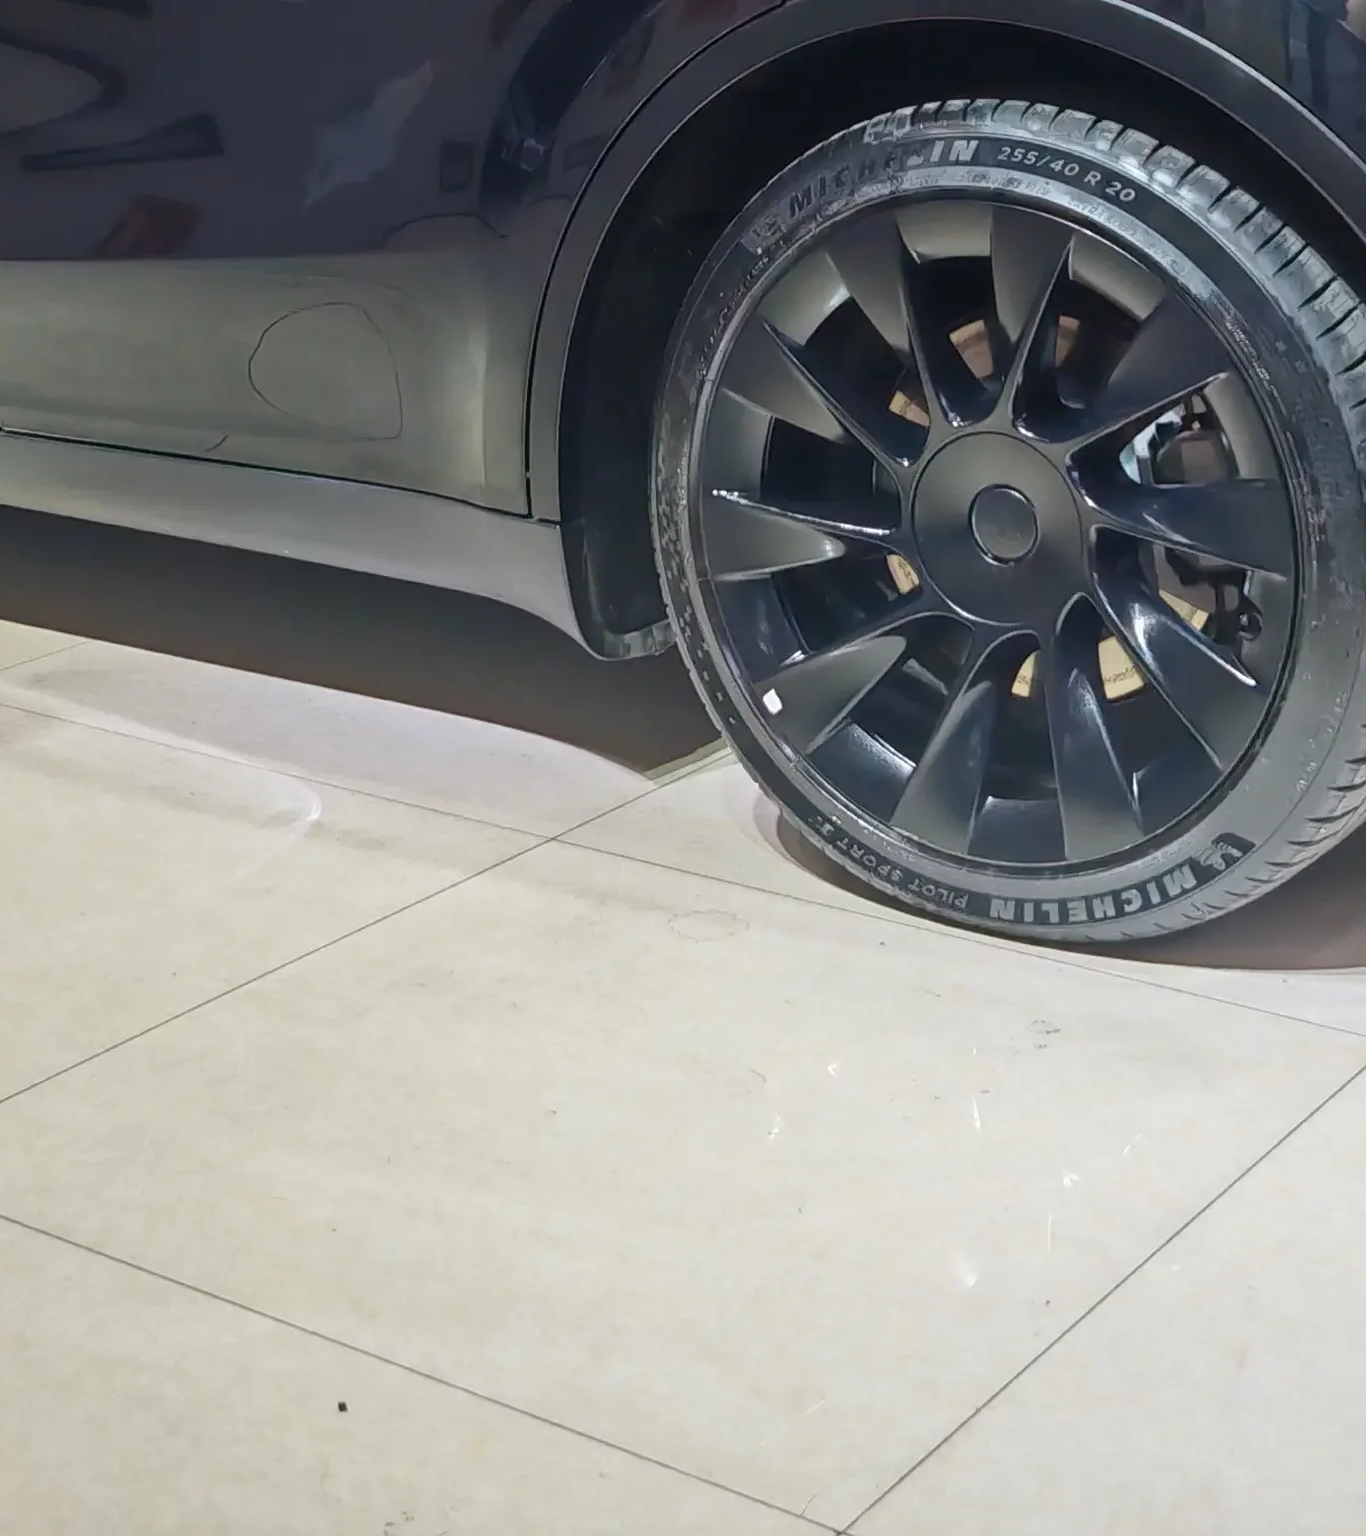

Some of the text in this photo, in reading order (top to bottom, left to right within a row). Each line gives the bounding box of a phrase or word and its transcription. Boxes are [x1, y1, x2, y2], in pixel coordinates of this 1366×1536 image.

[997, 146, 1137, 203] 255/40 R 20
[907, 877, 969, 908] PILOT
[990, 864, 1199, 924] MICHELIN
